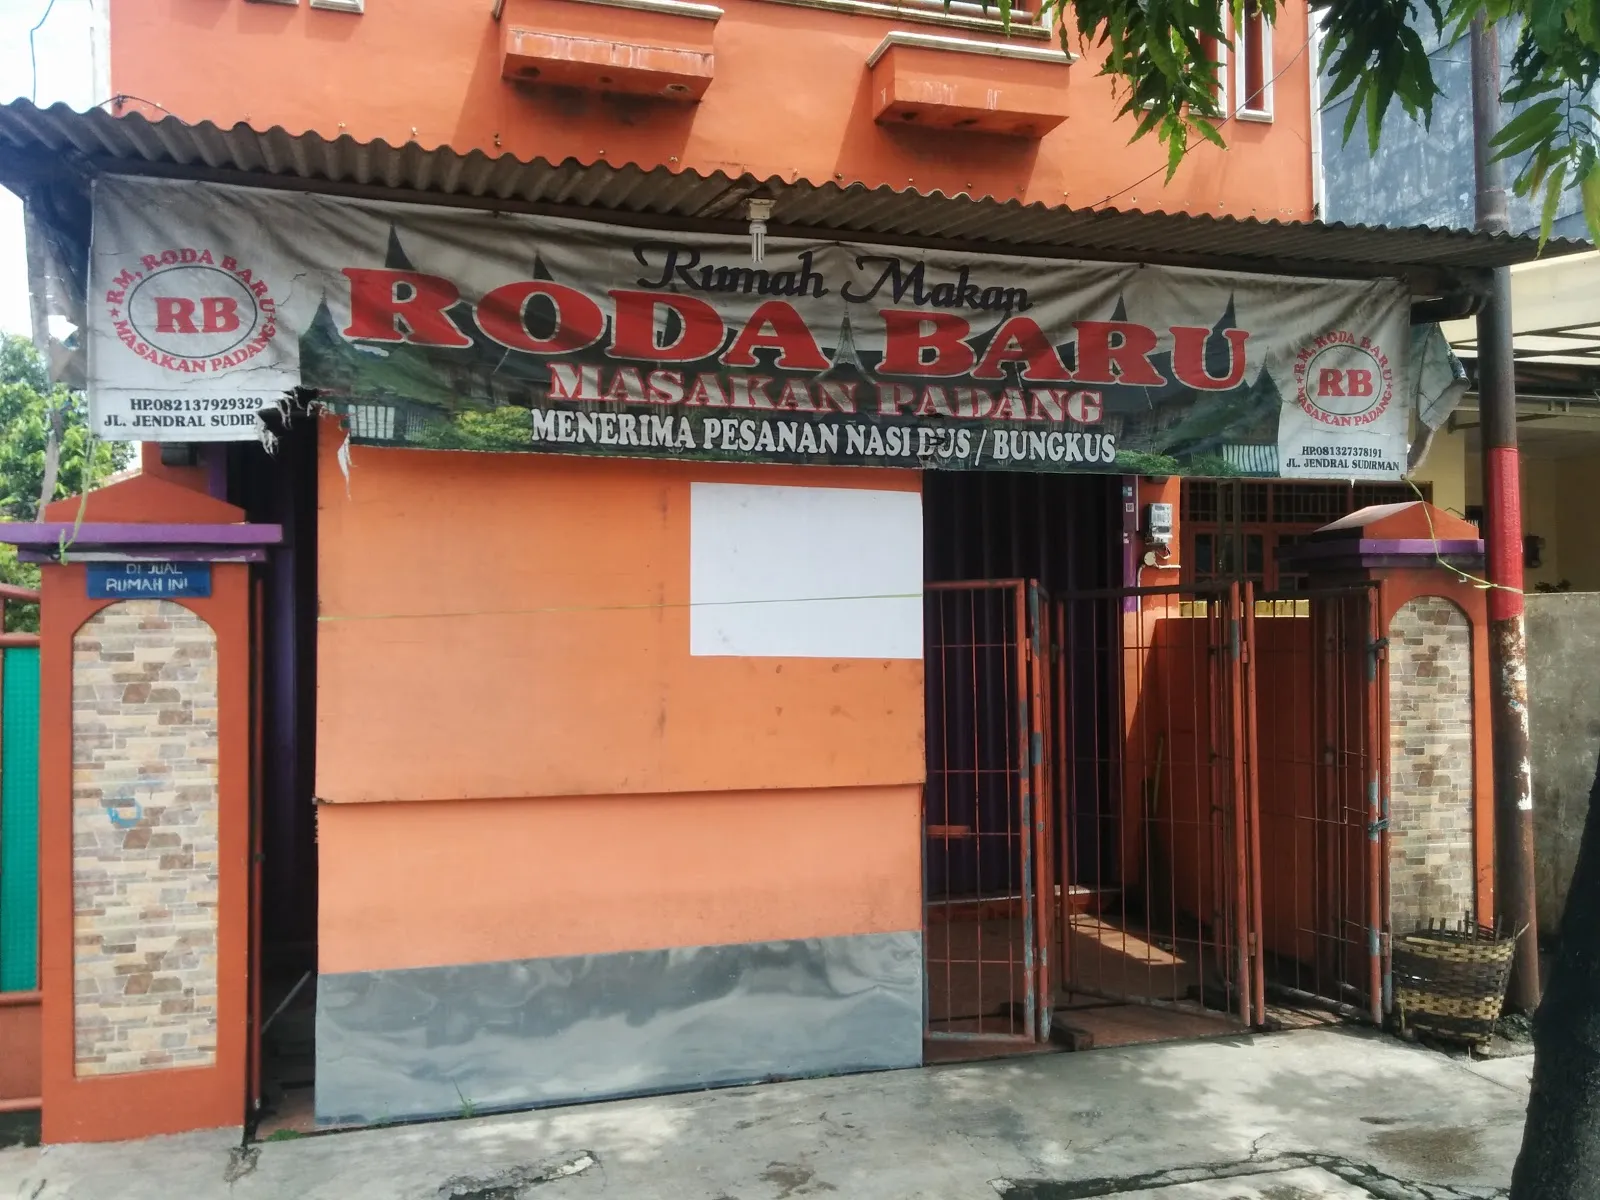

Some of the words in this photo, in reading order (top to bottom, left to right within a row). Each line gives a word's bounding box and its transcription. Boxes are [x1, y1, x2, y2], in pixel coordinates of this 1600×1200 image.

[140, 248, 214, 271] RODA
[220, 255, 276, 314] BARU
[633, 240, 828, 299] Rumah
[840, 255, 1033, 313] Makan
[154, 296, 240, 334] RB
[341, 266, 833, 371] RODA
[875, 308, 1250, 391] BARU
[113, 319, 206, 373] MASAKAN
[210, 324, 276, 372] PADANG
[1313, 330, 1355, 349] RODA
[1360, 336, 1392, 381] BARU
[546, 362, 858, 414] MASAKAN
[873, 380, 1104, 425] PADANG
[1317, 368, 1374, 397] RB
[104, 414, 127, 427] JL.
[132, 414, 206, 427] JENDRAL
[210, 413, 258, 427] SUDIR
[1297, 386, 1351, 427] MASAKAN
[1353, 390, 1393, 426] PADANG
[531, 408, 697, 449] MENERIMA
[703, 417, 840, 455] PESANAN
[845, 423, 911, 457] NASI
[917, 426, 971, 459] DUS
[974, 429, 987, 467] /
[992, 429, 1117, 464] BUNGKUS
[1286, 458, 1300, 468] JL.
[1304, 458, 1349, 469] JENDRAL
[1351, 459, 1400, 471] SUDIRMAN
[106, 578, 163, 592] RUMAH
[168, 578, 188, 591] INI
[126, 563, 141, 575] DI
[148, 563, 183, 575] JUAL
